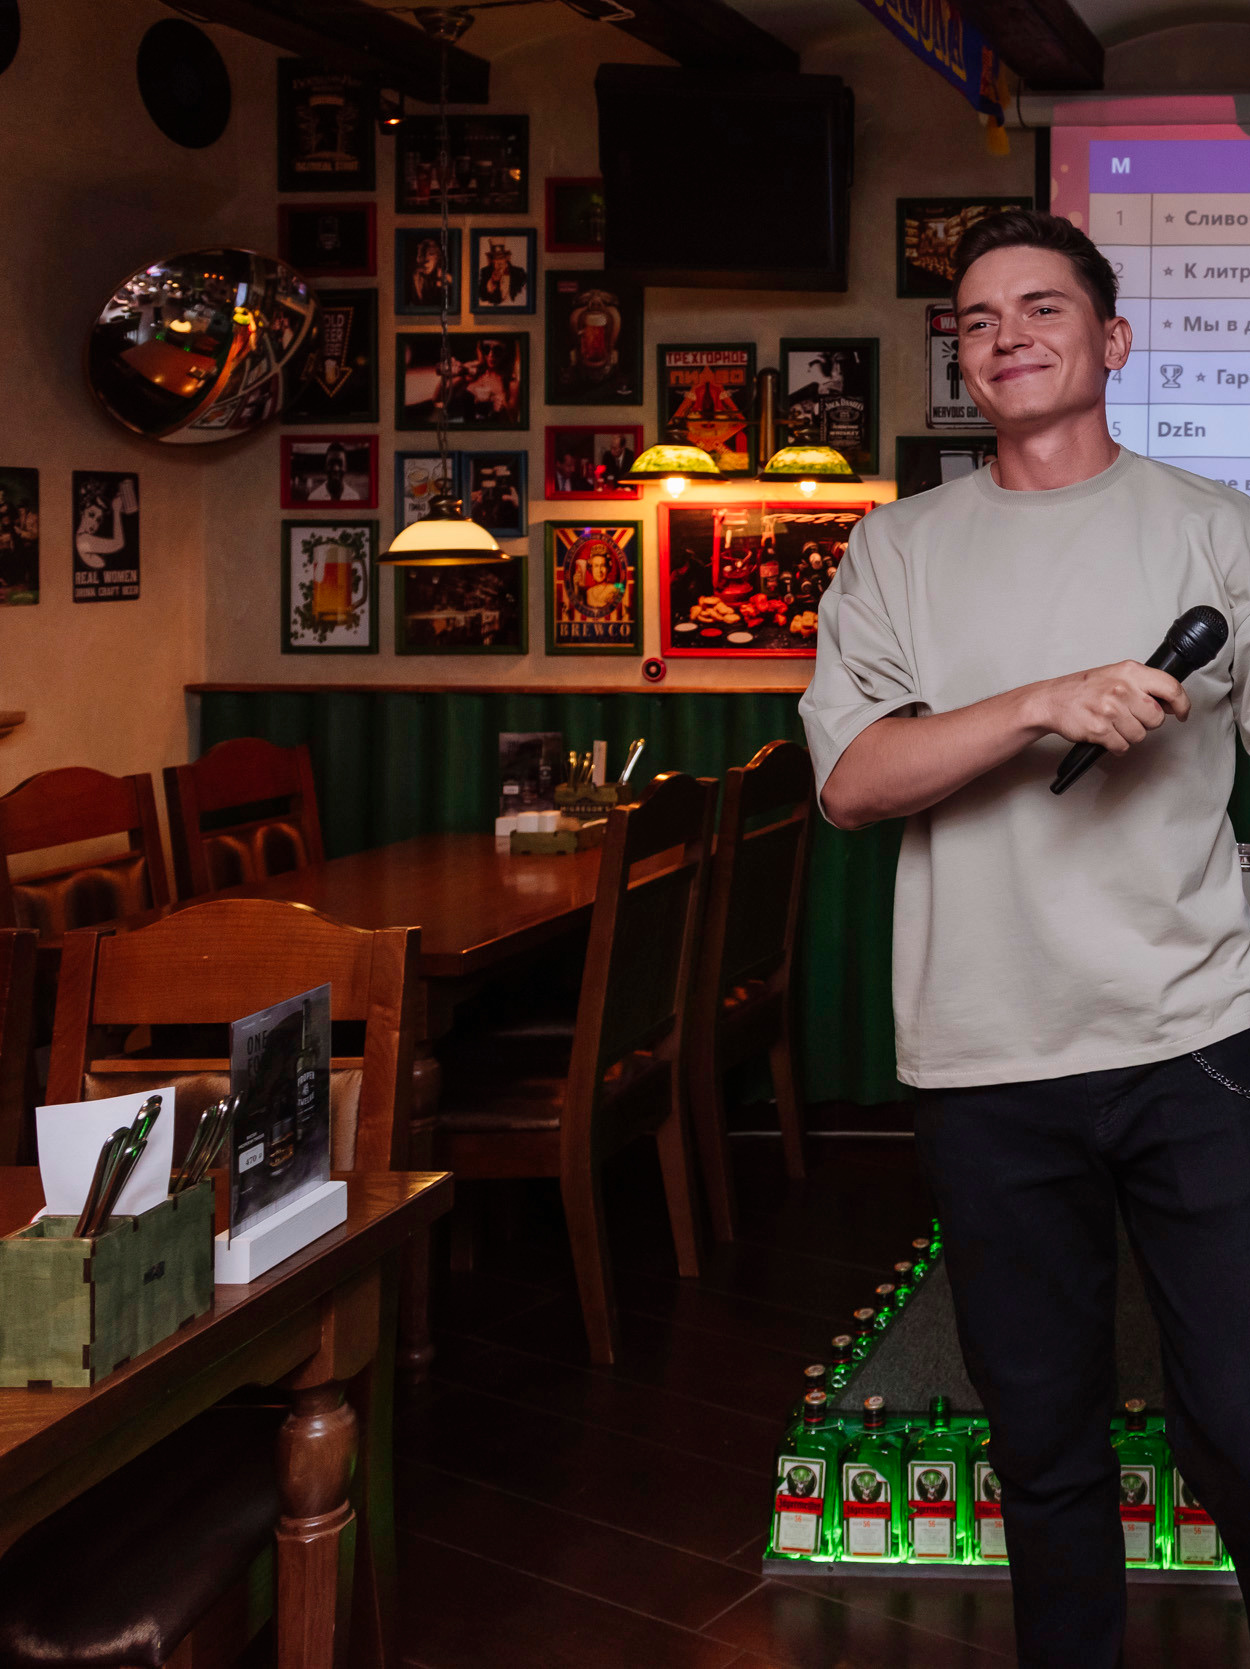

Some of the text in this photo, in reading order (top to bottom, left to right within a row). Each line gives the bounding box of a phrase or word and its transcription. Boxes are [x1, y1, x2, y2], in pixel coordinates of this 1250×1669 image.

[1116, 210, 1123, 225] 1
[1113, 263, 1123, 278] 2
[1185, 263, 1196, 278] К
[1184, 316, 1219, 332] Мы
[1227, 320, 1237, 331] в
[667, 352, 748, 364] ТРЕХГОРНОЕ
[933, 406, 965, 418] NERVOUS
[1111, 422, 1121, 438] 5
[1158, 422, 1205, 437] DzEn
[75, 569, 137, 585] REAL WOMEN
[560, 624, 631, 637] BREWCO
[247, 1030, 270, 1055] ONE
